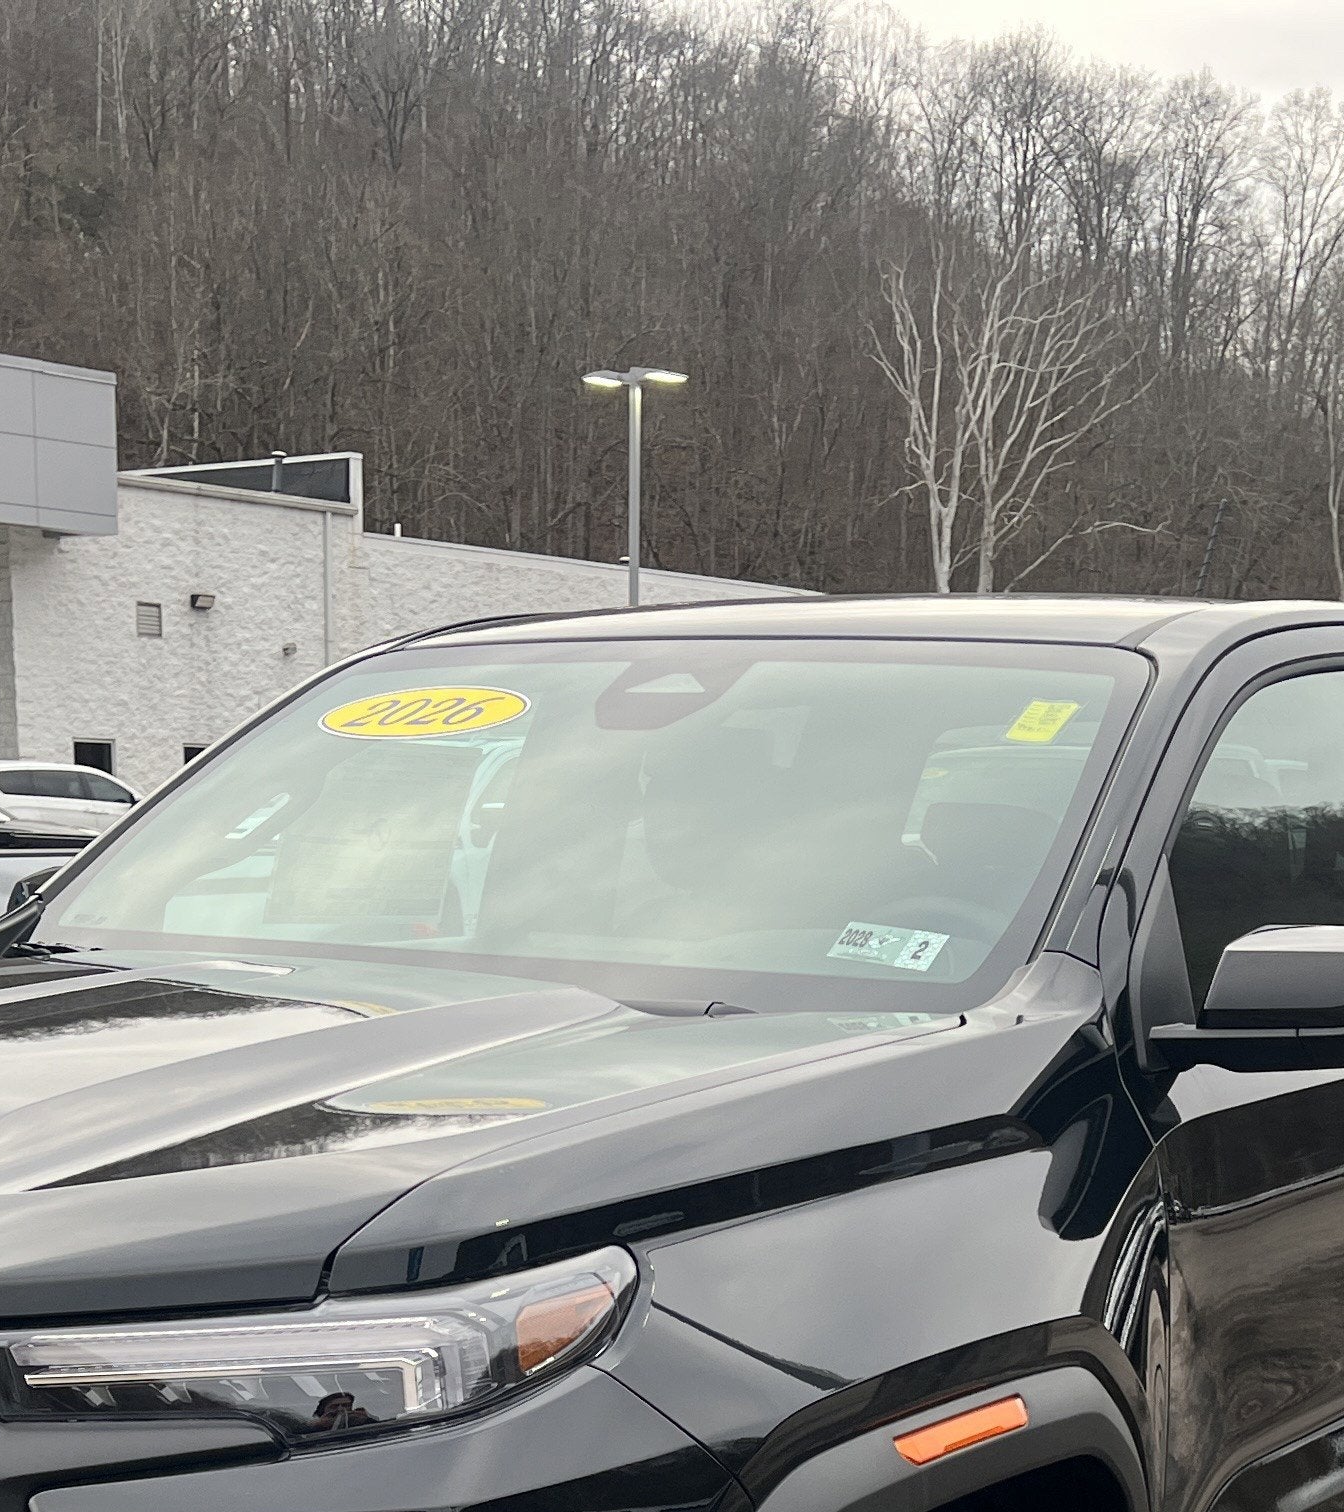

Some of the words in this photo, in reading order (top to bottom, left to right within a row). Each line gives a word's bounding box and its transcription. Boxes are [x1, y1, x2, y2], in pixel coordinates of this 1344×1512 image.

[340, 697, 507, 728] 2026
[837, 928, 873, 948] 2028
[910, 940, 930, 960] 2
